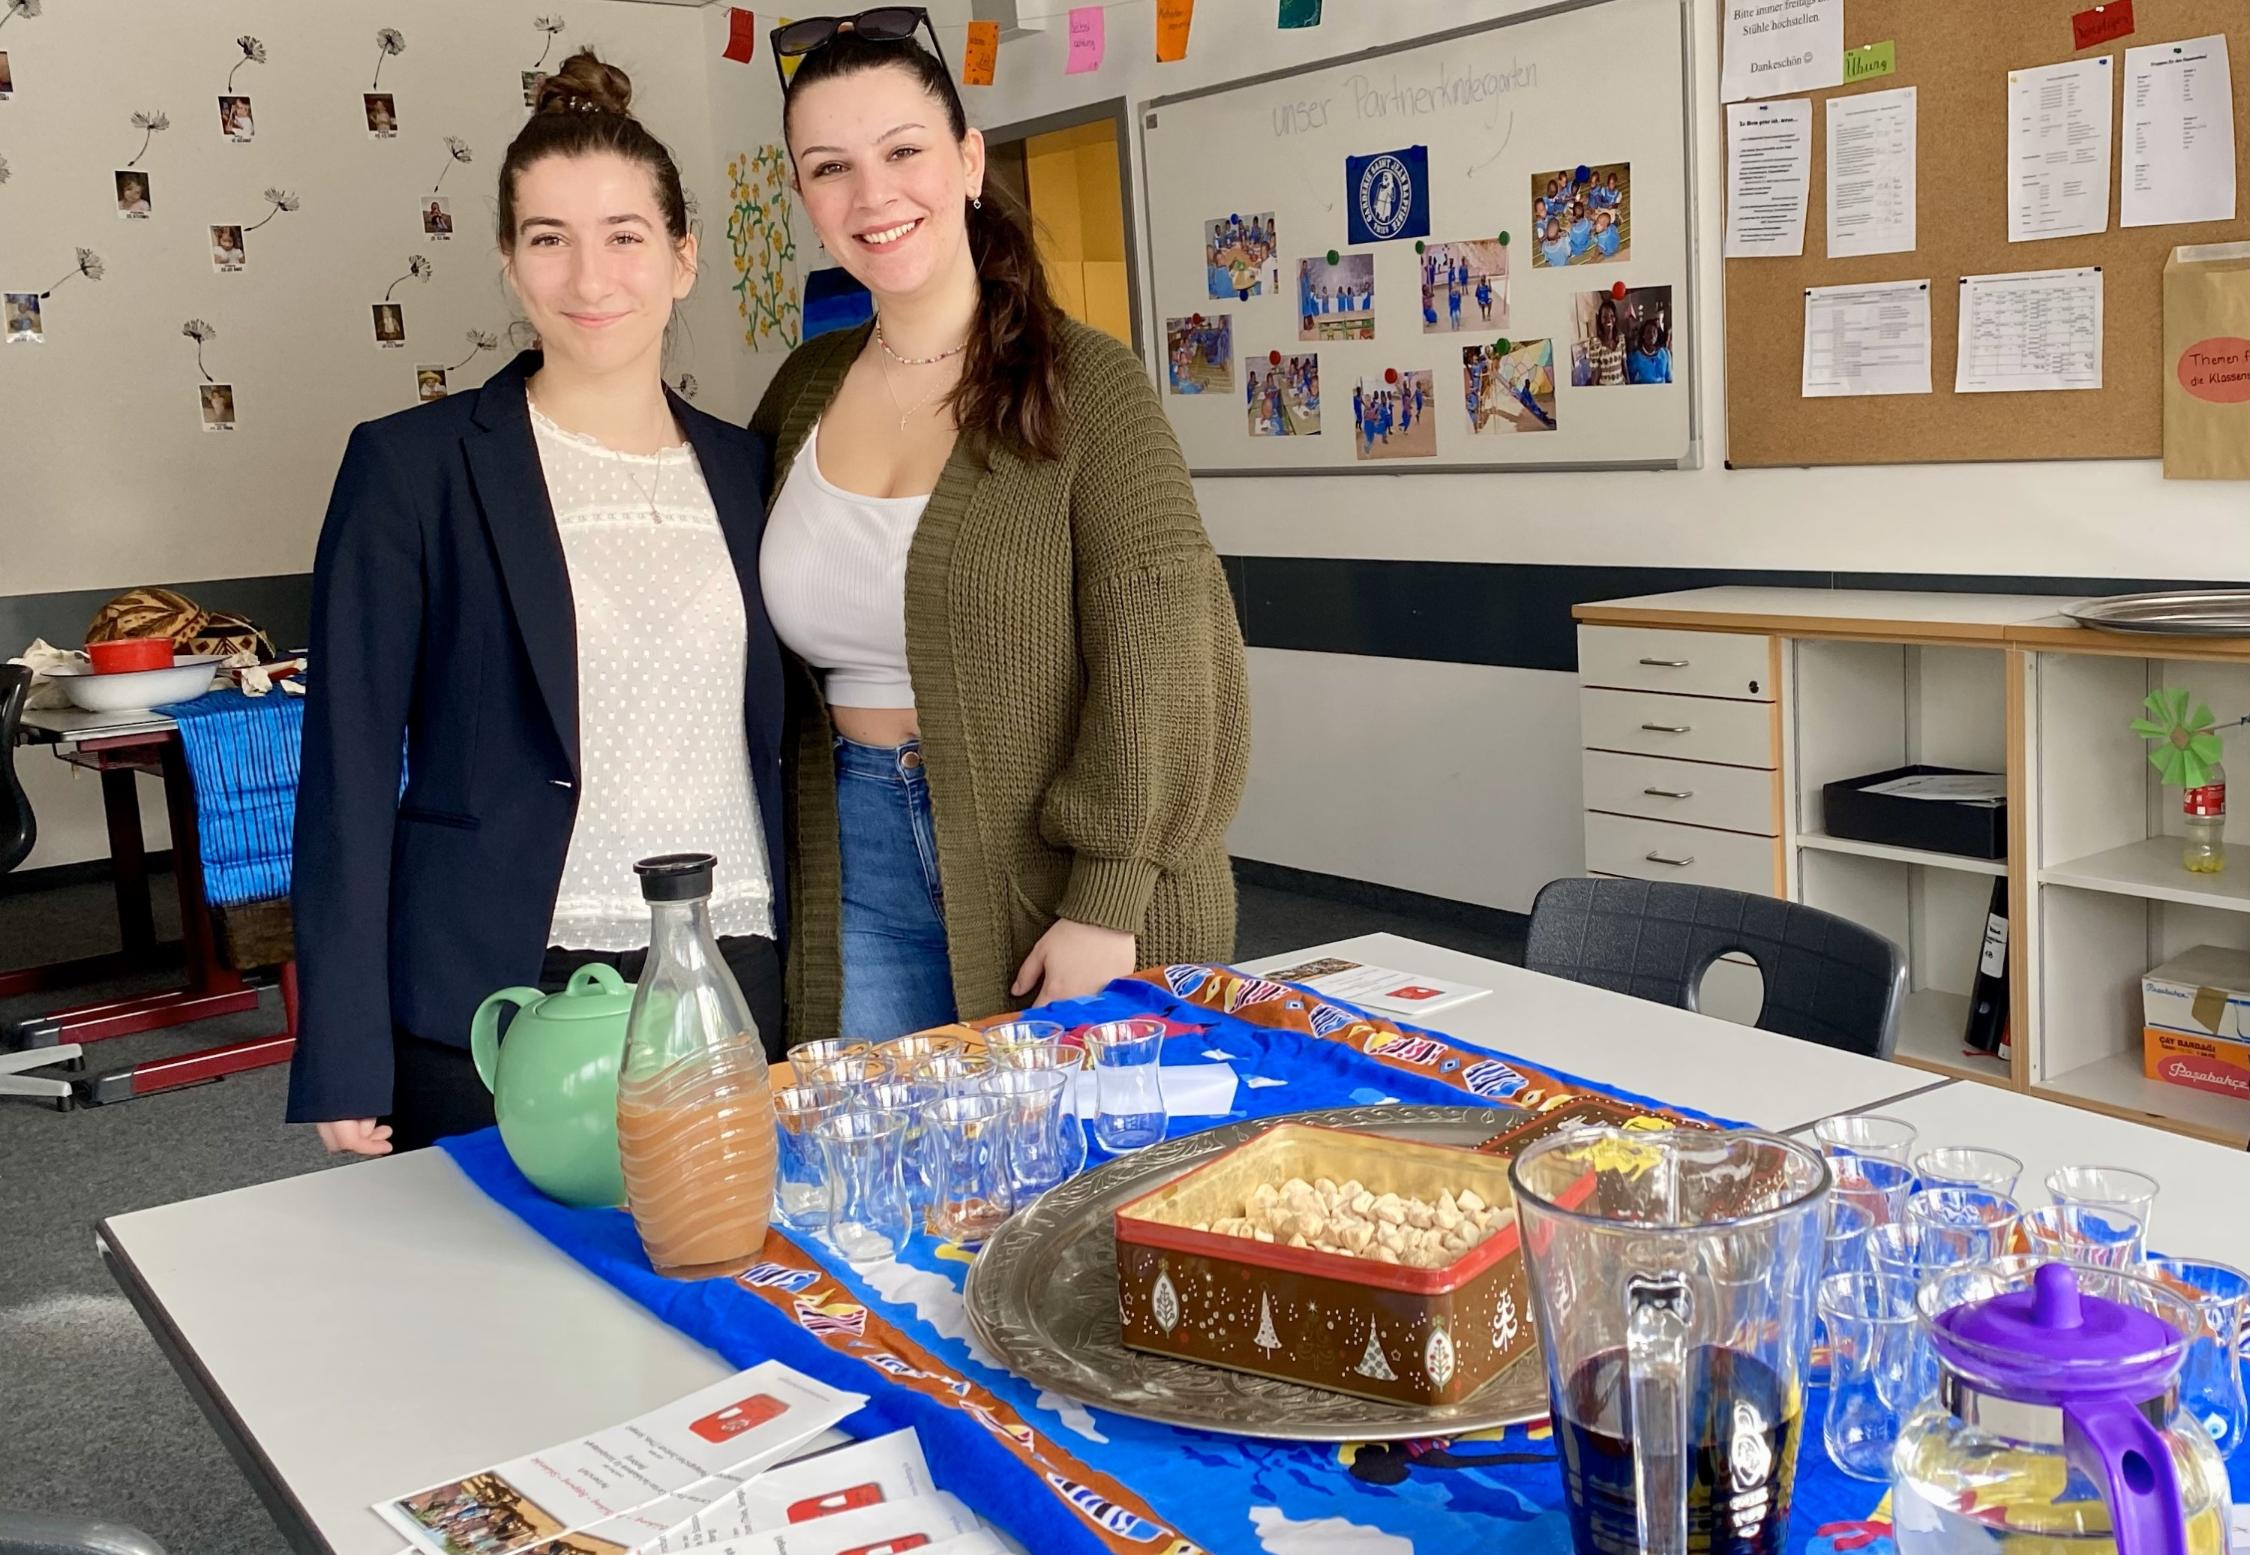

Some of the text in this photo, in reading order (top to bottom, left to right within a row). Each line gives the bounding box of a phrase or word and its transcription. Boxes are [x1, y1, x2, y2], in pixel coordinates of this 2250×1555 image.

[1733, 9, 1754, 21] Bitte
[1756, 3, 1783, 16] immer
[1742, 21, 1770, 36] Stühle
[1750, 54, 1802, 74] Dankeschön
[1272, 56, 1537, 137] unser Partnerkindergarten
[2188, 352, 2239, 368] Themen
